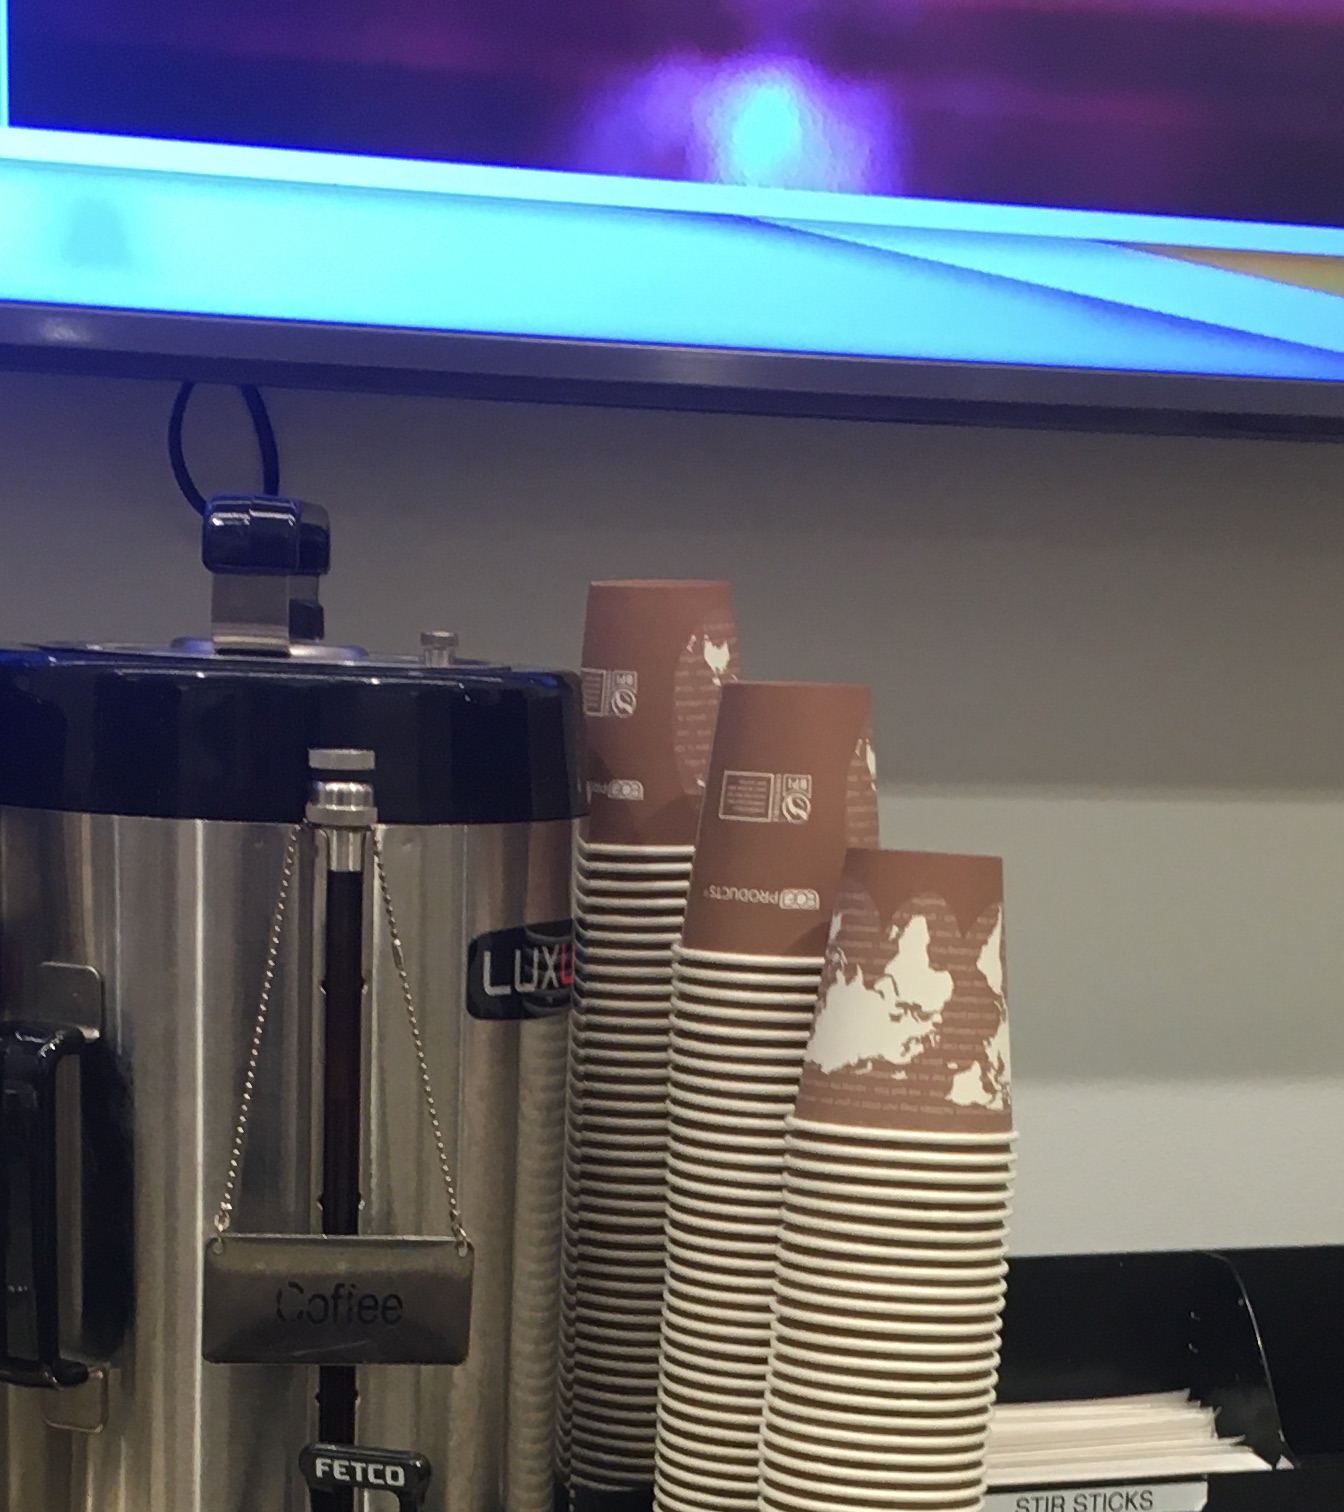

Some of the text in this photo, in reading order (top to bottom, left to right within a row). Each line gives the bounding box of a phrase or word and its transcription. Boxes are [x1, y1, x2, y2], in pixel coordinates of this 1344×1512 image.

[709, 885, 779, 904] PRODUCTS
[483, 943, 578, 996] LUXU
[315, 1457, 405, 1487] FETCO
